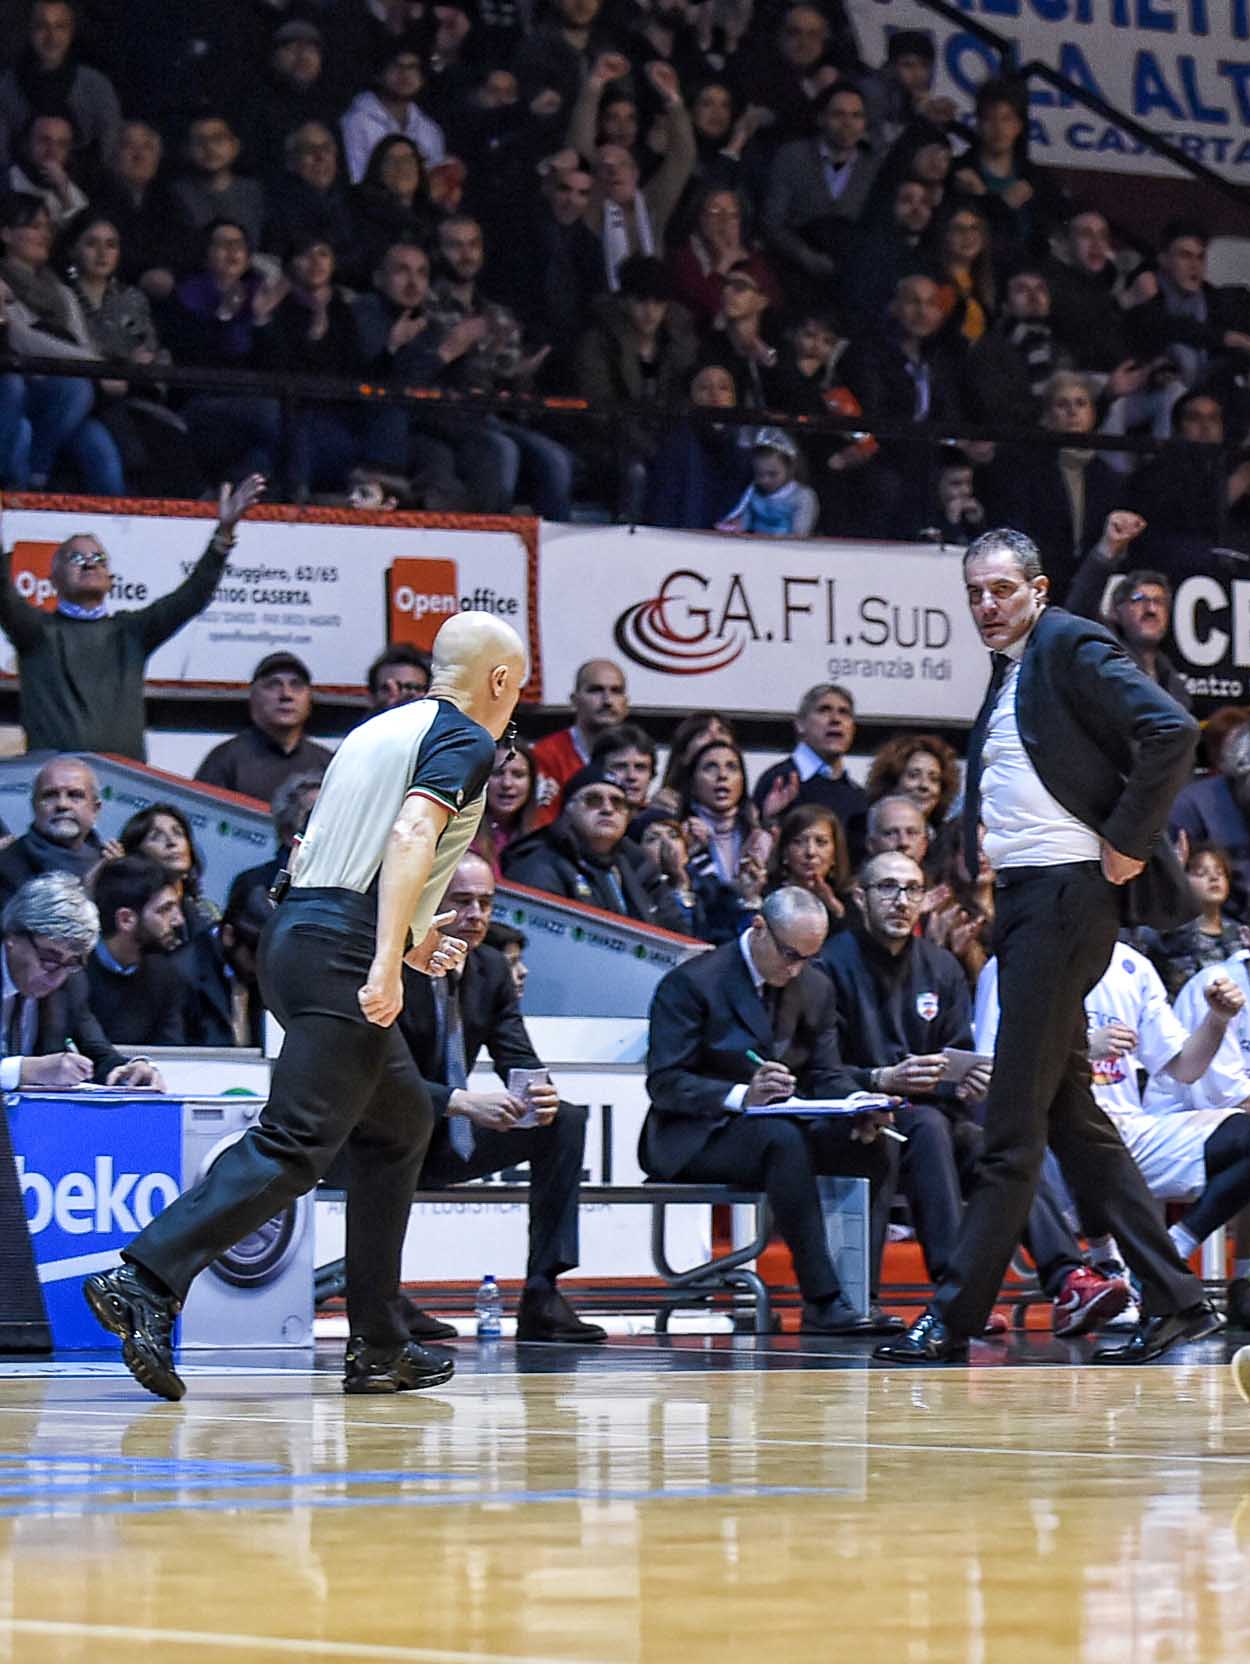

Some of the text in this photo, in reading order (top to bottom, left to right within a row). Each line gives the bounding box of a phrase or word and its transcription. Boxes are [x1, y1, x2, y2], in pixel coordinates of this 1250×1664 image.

[214, 588, 312, 605] 1100 CASERTA
[827, 655, 952, 681] garanzia fidi
[14, 1154, 181, 1235] beko
